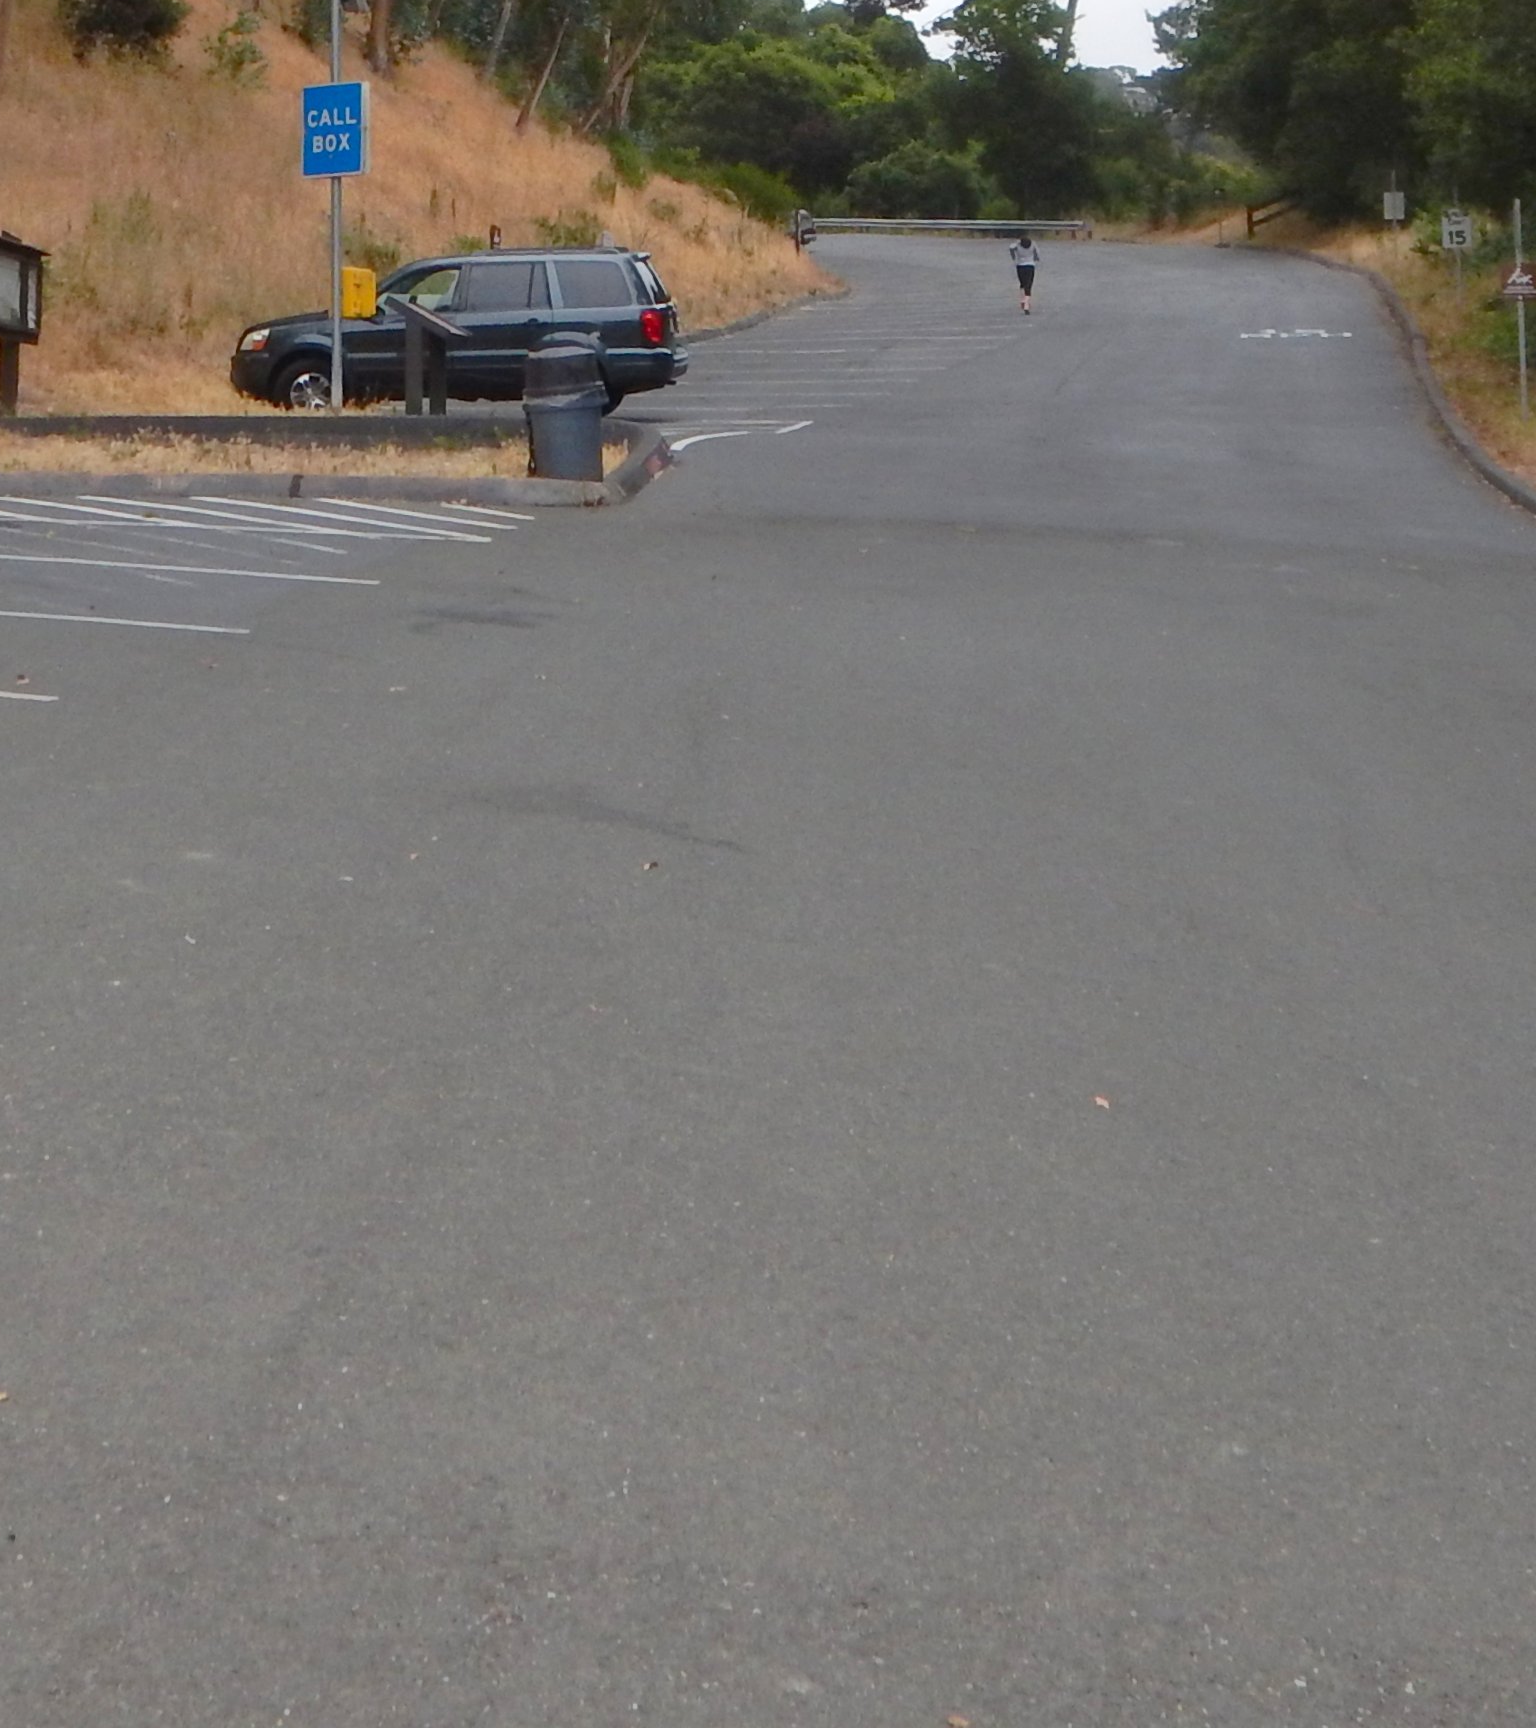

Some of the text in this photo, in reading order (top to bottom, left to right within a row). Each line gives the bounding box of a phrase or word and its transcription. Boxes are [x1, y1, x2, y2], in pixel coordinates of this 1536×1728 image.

[307, 106, 358, 128] CALL
[312, 132, 350, 153] BOX
[1448, 230, 1466, 246] 15
